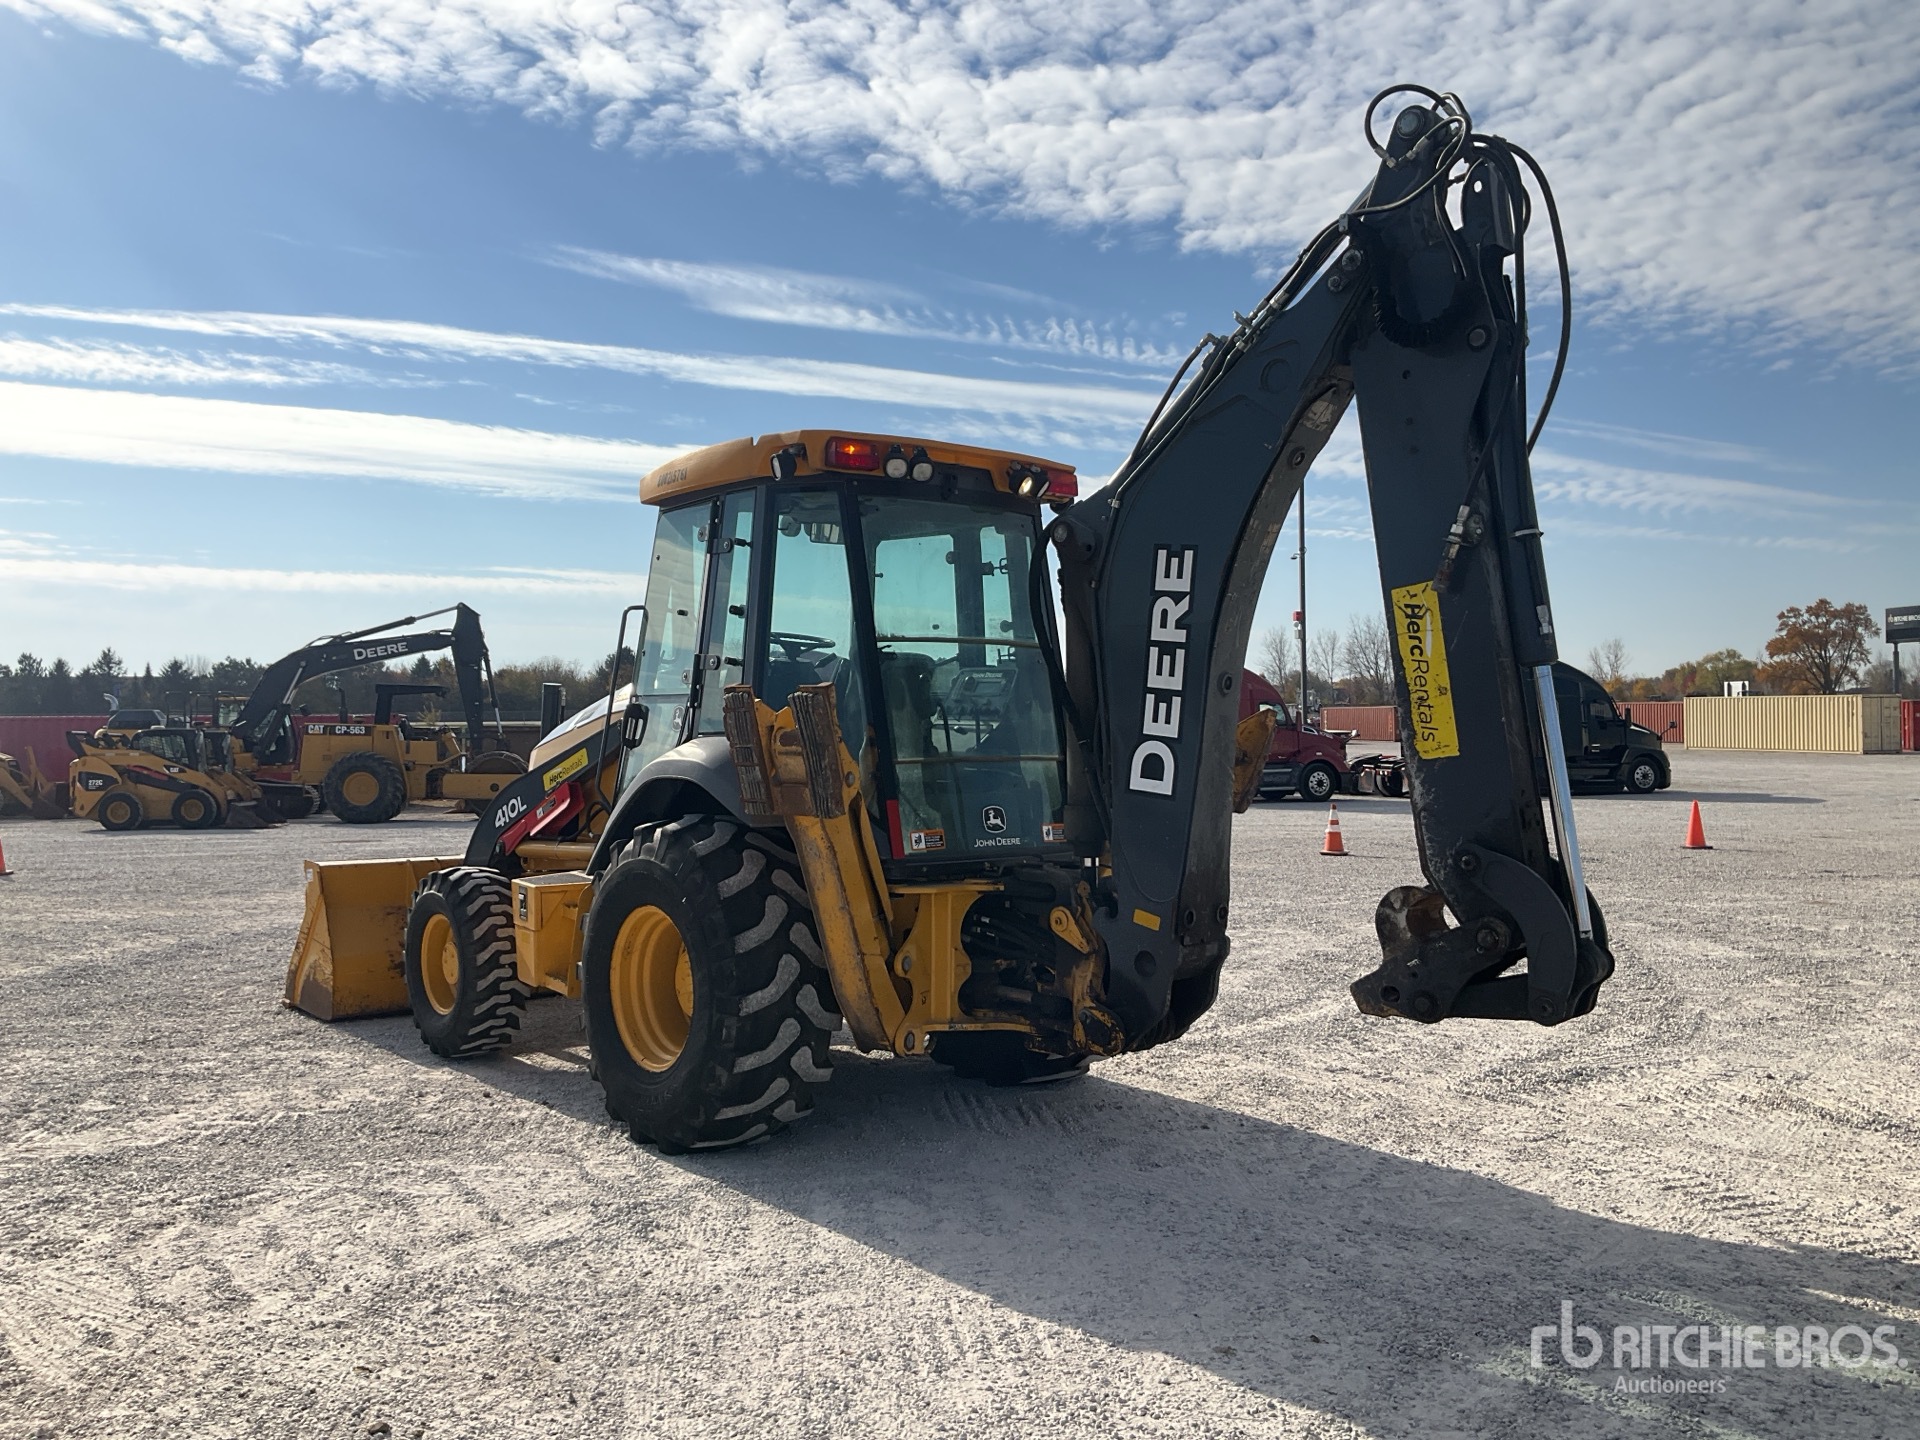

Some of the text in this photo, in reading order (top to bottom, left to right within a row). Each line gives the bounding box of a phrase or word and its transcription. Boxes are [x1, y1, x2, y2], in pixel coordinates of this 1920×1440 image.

[353, 642, 409, 661] DEERE
[1129, 549, 1194, 796] DEERE
[308, 724, 366, 734] CAT CP-563
[549, 759, 583, 785] HercRentals
[494, 796, 527, 828] 410L
[974, 837, 1021, 848] JOHN DEERE
